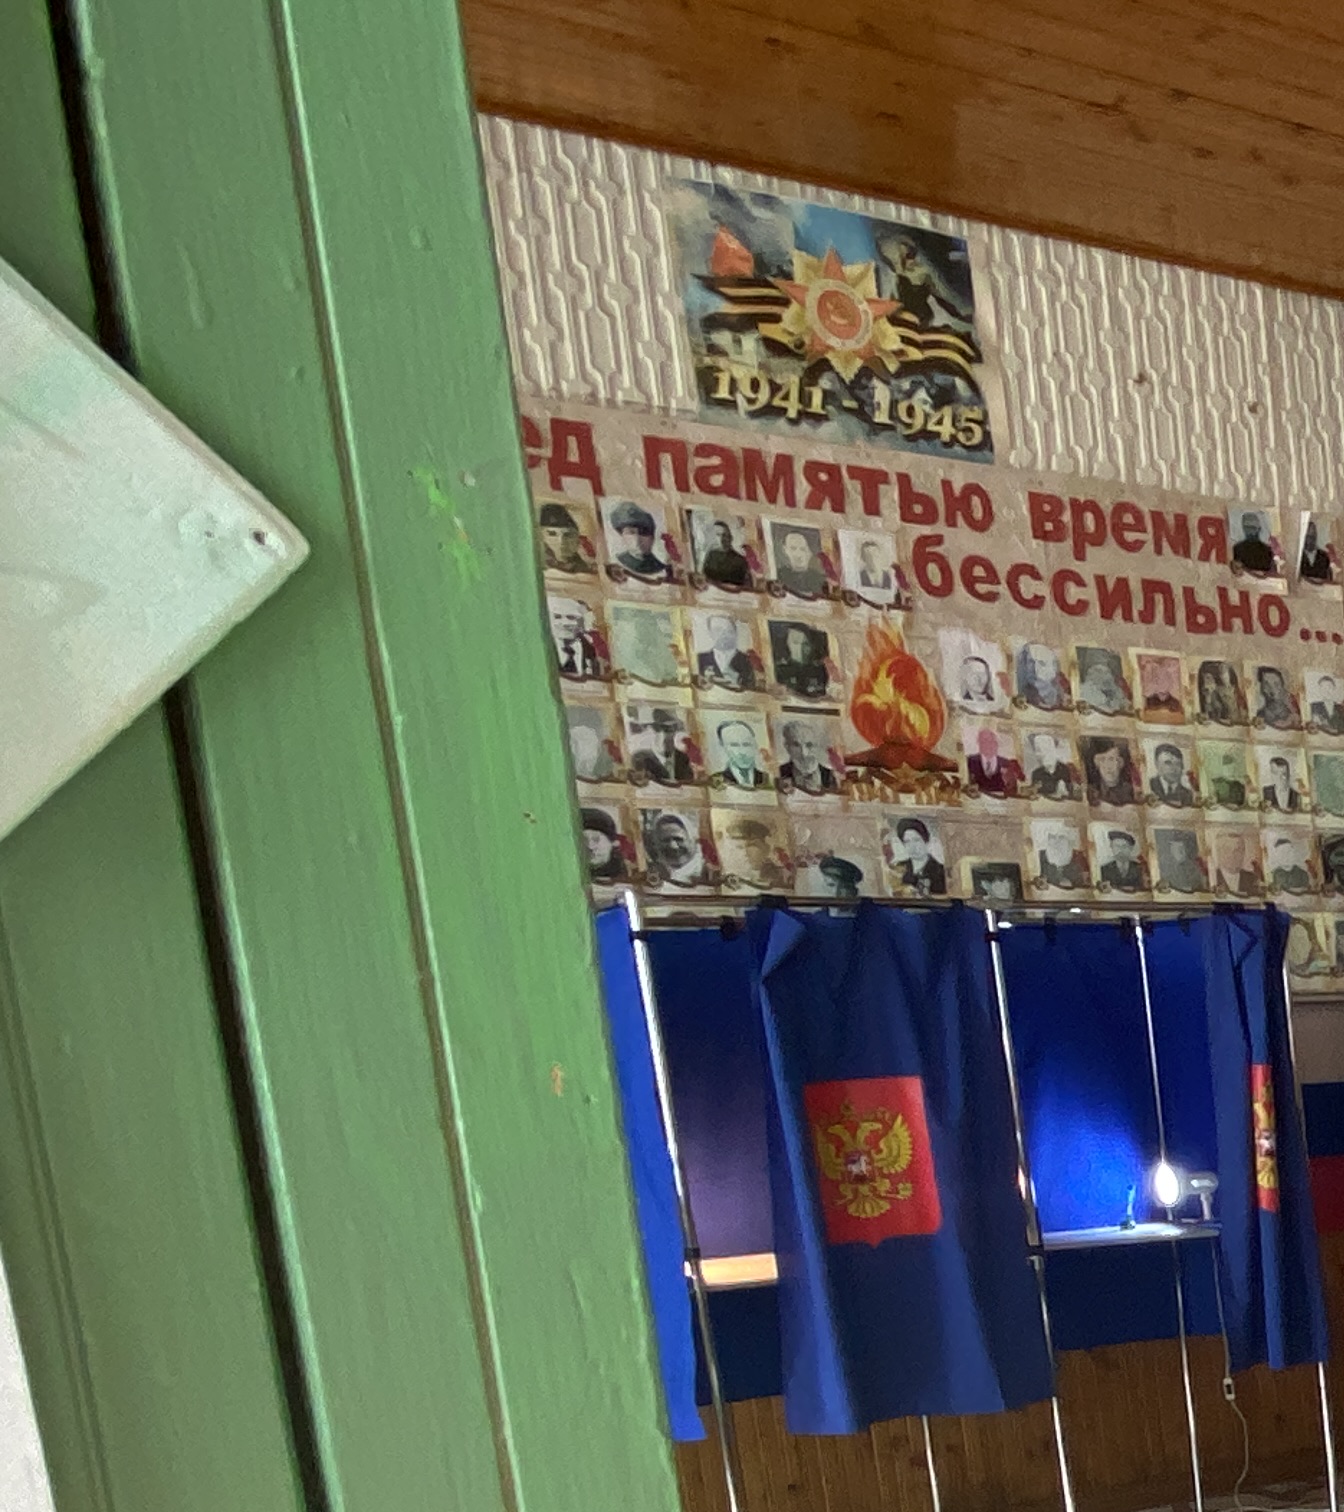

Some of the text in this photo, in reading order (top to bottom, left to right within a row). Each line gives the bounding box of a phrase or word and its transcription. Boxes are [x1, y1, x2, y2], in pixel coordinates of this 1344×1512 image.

[709, 369, 827, 420] 1941
[871, 376, 985, 446] 1945
[643, 434, 995, 533] памятью
[1027, 490, 1228, 564] время
[911, 533, 1344, 646] бессильно...
